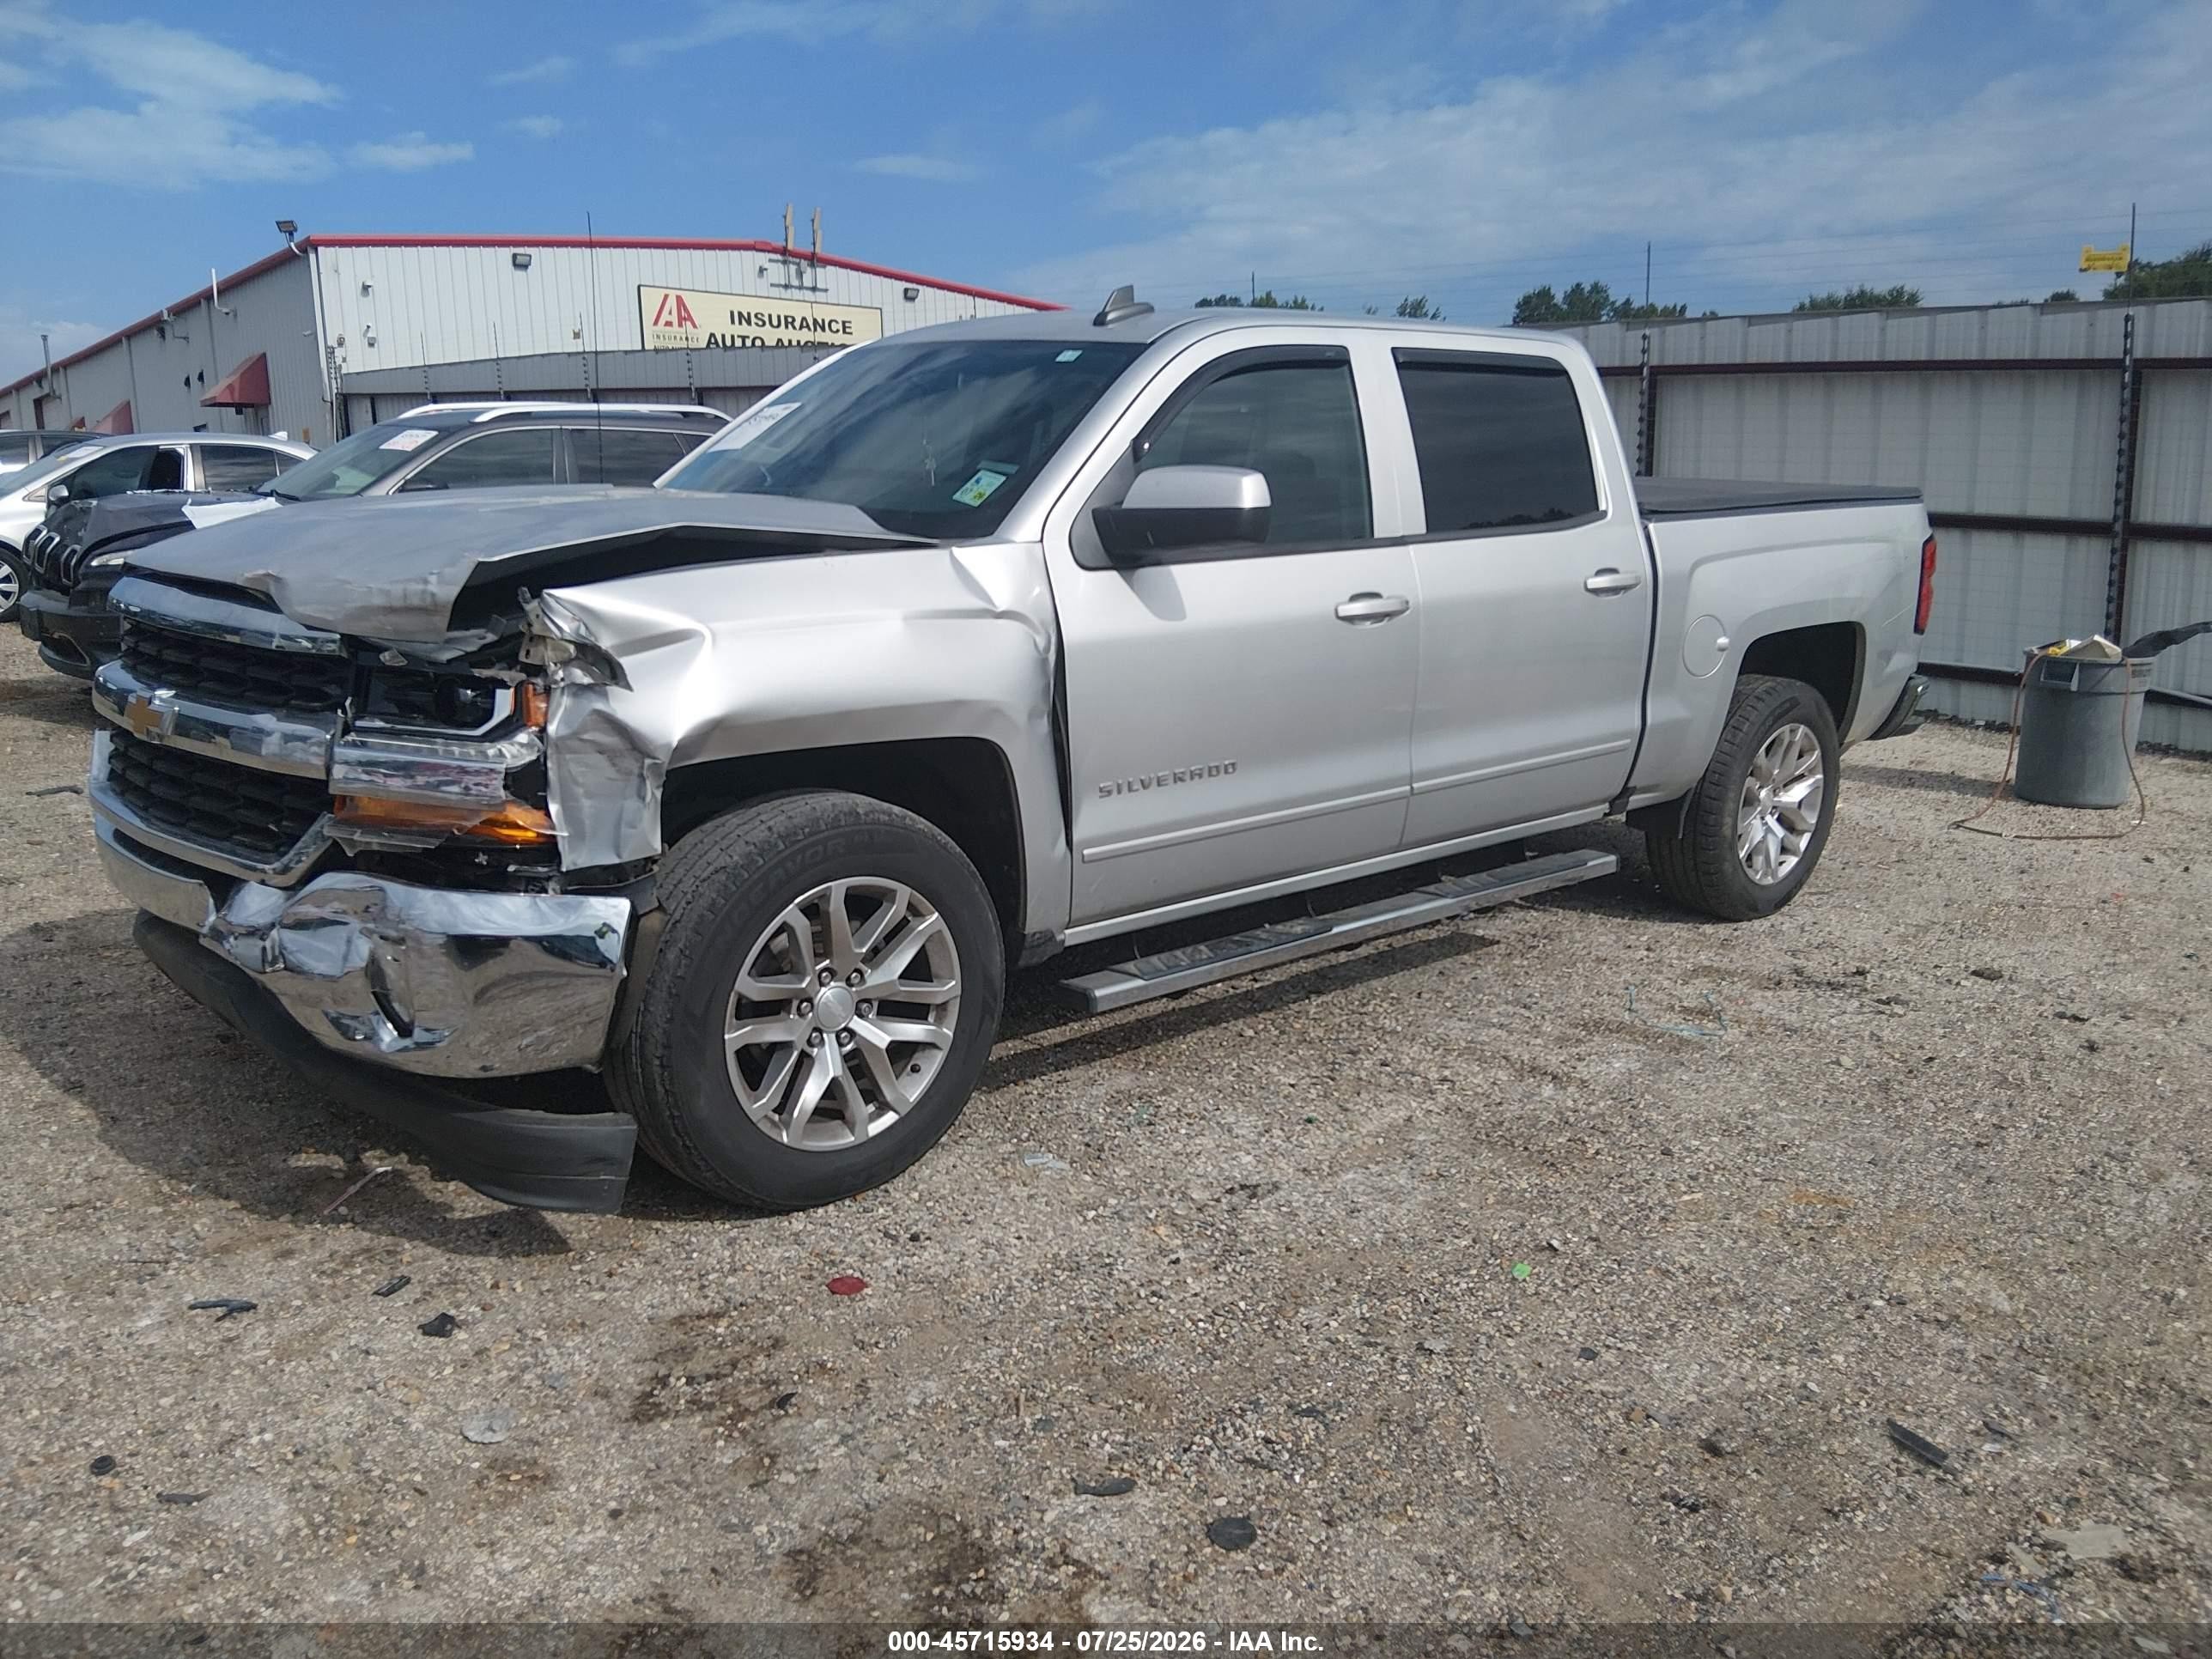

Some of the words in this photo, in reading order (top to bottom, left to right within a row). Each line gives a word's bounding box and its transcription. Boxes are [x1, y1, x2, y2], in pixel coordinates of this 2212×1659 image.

[730, 310, 853, 334] INSURANCE
[653, 333, 700, 343] INSURANCE
[706, 332, 766, 348] AUTO
[1098, 759, 1237, 799] SILVERADO
